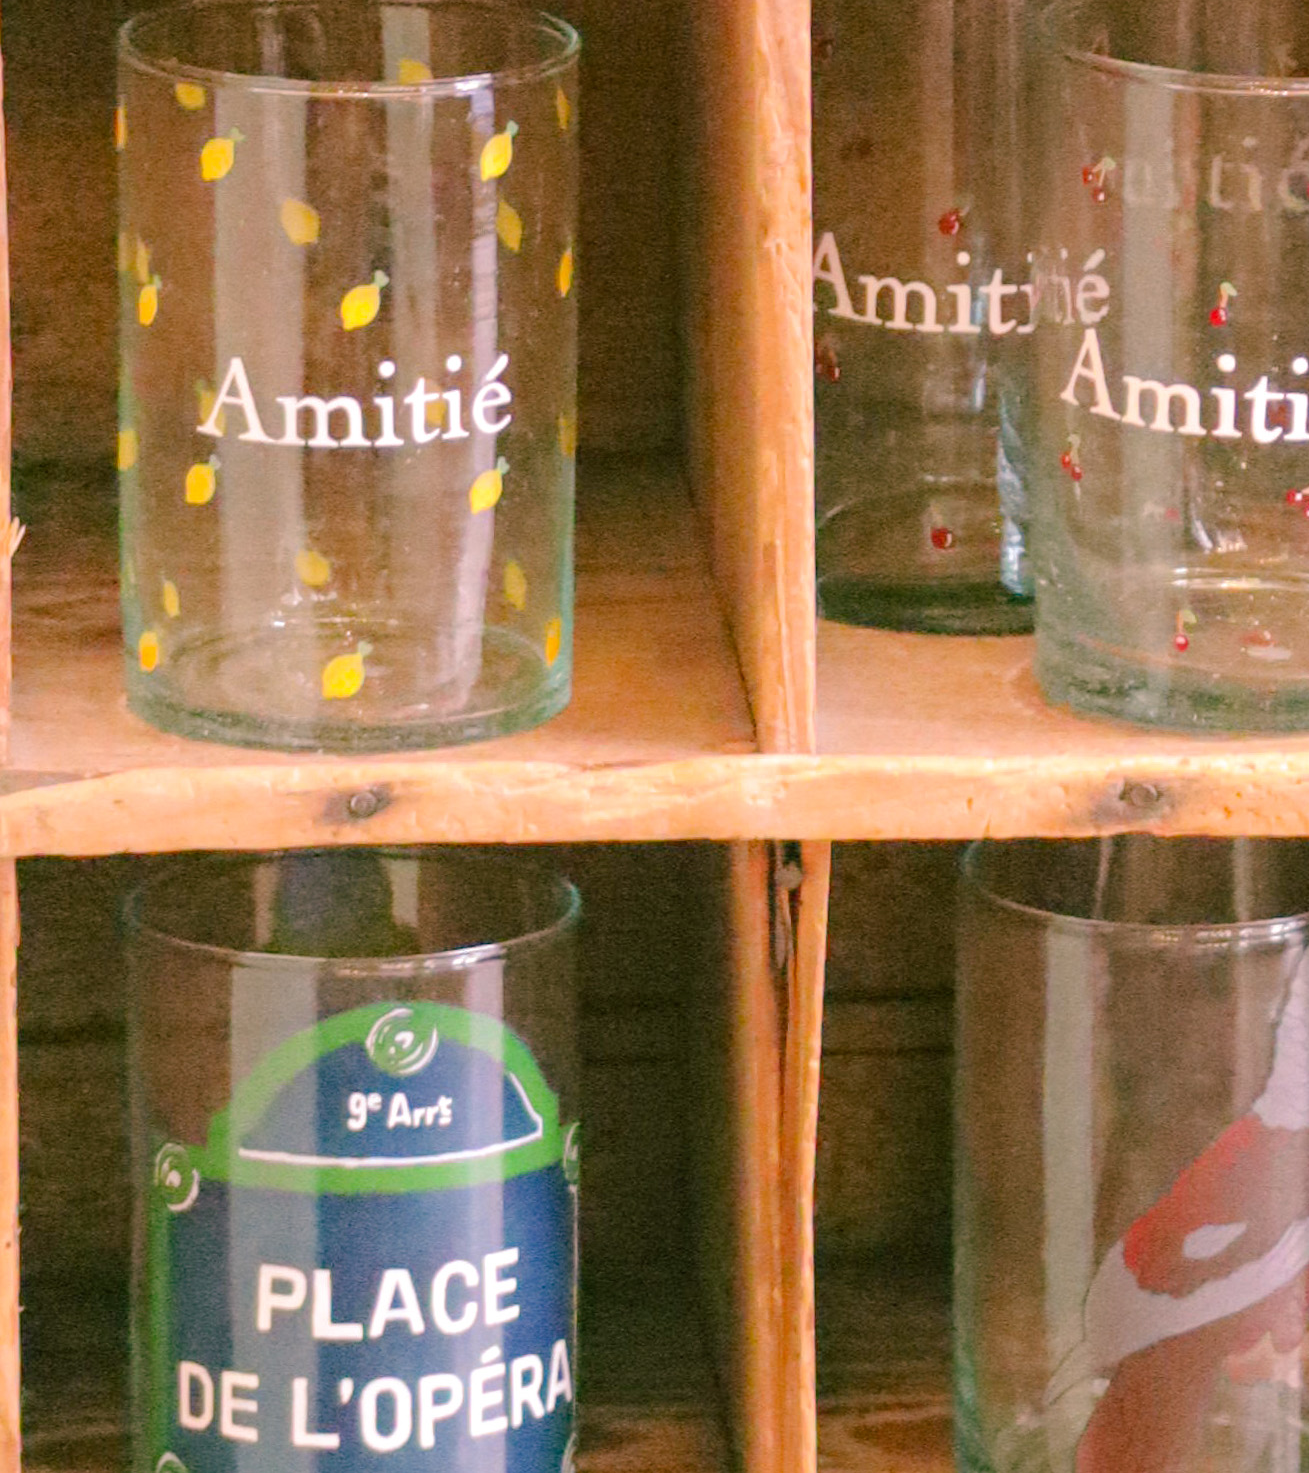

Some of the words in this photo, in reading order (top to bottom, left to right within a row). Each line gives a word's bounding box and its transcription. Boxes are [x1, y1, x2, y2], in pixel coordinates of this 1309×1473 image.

[195, 353, 514, 450] Amitié
[346, 1090, 383, 1132] 9e
[386, 1091, 453, 1131] Arrt
[255, 1246, 521, 1343] PLACE
[177, 1359, 260, 1445] DE
[291, 1337, 574, 1454] L'OPÉRA
